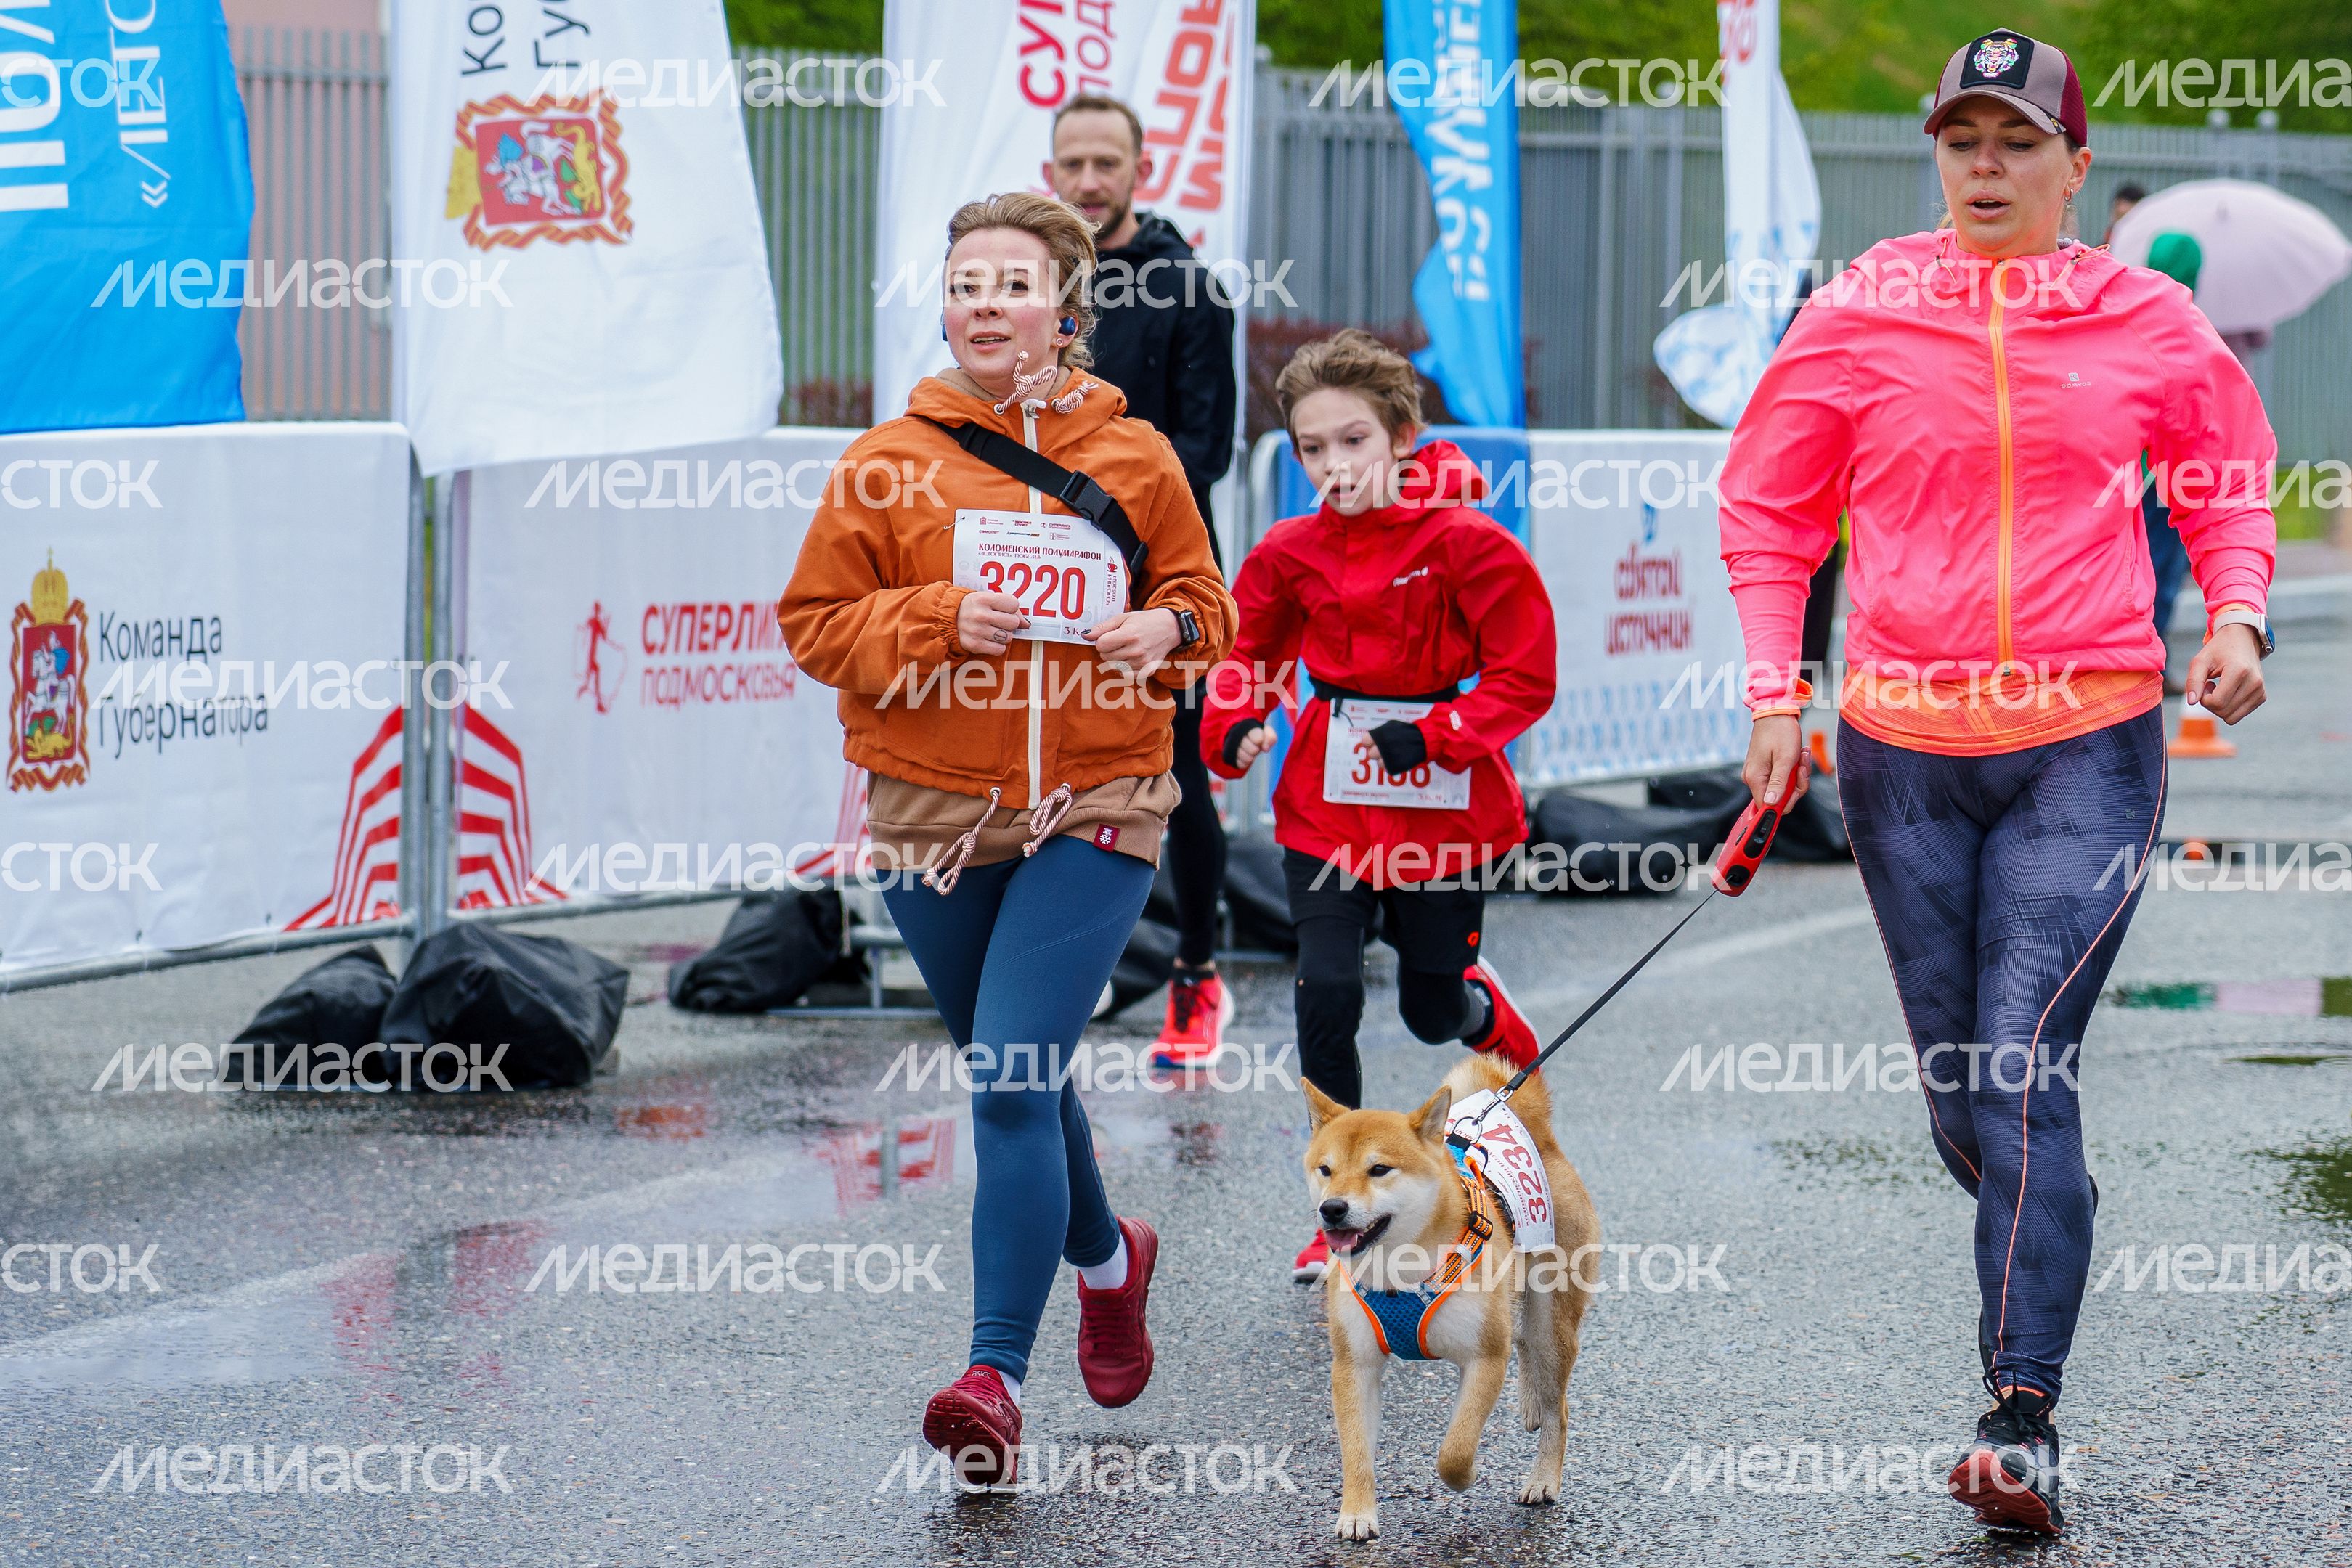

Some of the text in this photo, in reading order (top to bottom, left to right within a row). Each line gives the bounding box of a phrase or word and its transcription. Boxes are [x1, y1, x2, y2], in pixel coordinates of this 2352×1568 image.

[978, 543, 1102, 560] КОЛОМЕНСКИЙ ПОЛУМАРАФОН
[980, 560, 1086, 620] 3220
[100, 610, 222, 666] Команда
[99, 692, 269, 759] Губернатора
[1481, 1123, 1547, 1223] 3234
